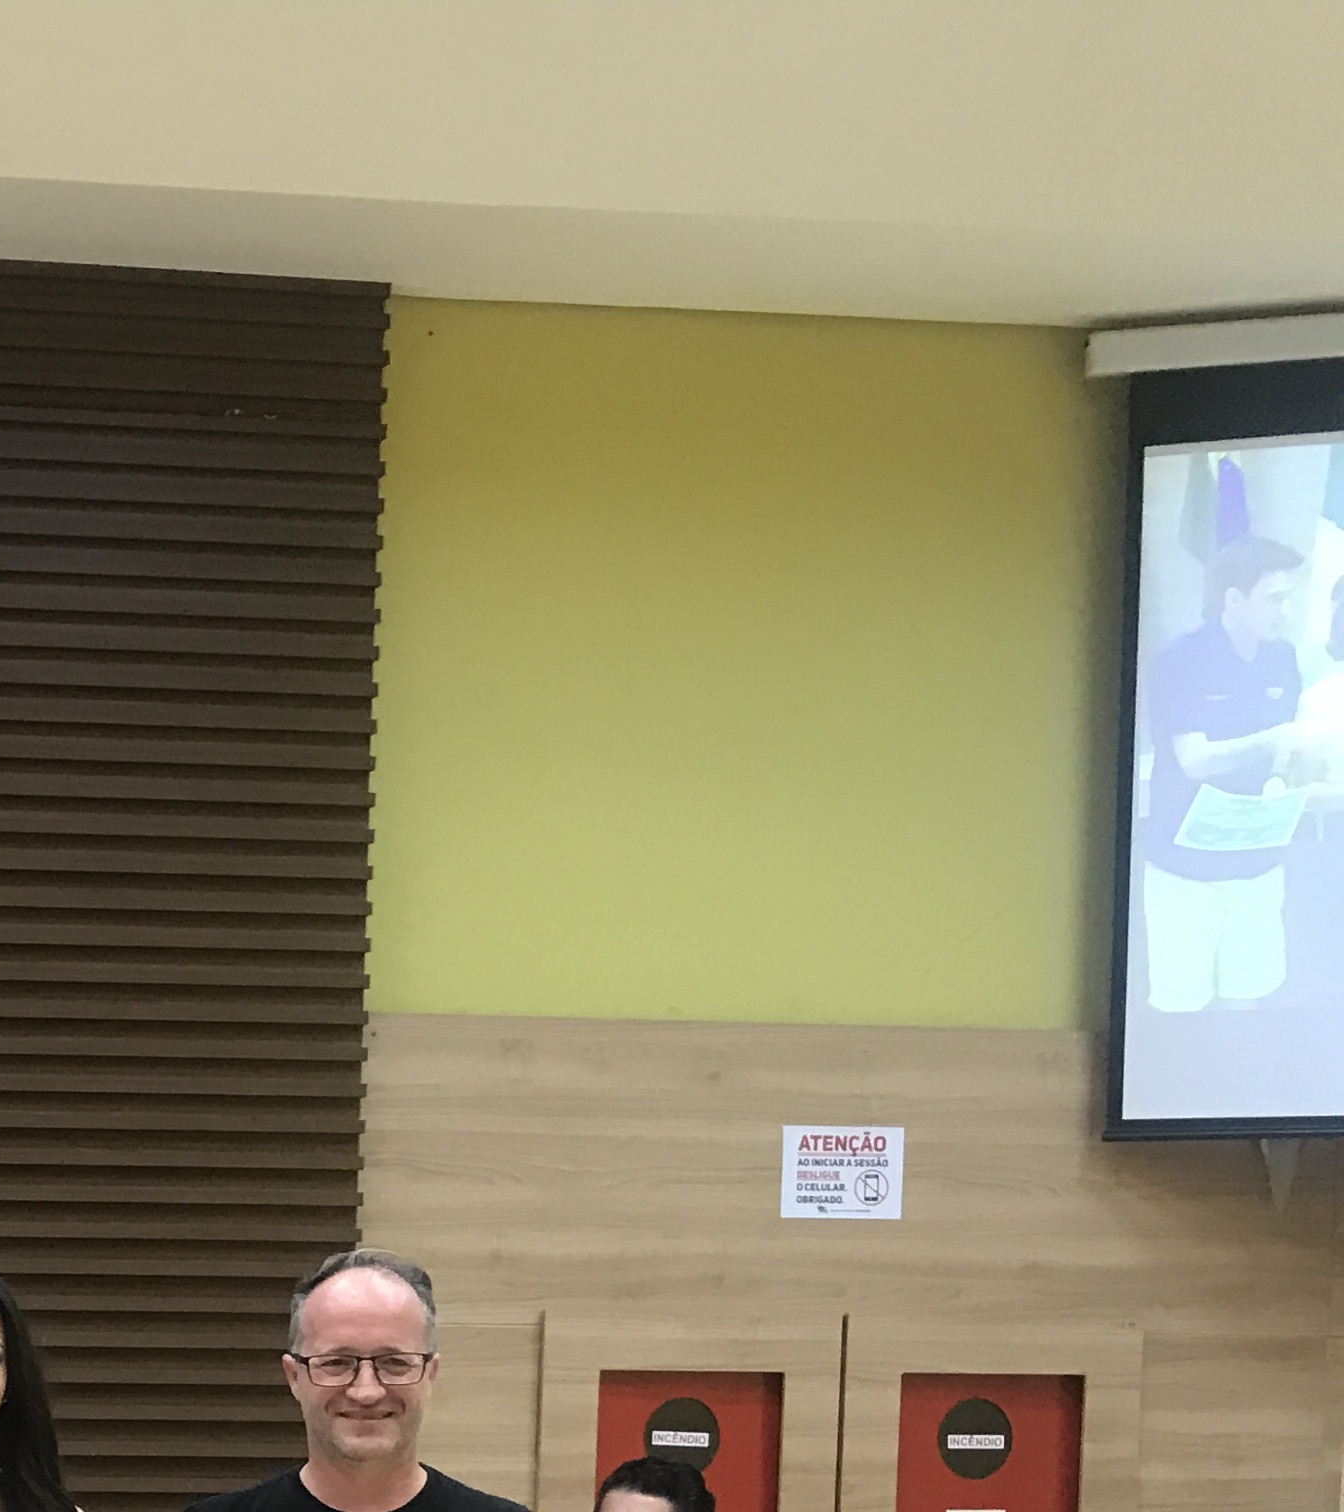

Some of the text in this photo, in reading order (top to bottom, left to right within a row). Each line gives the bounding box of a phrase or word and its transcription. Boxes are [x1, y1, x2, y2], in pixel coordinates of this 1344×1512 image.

[798, 1131, 887, 1157] ATENÇÃO
[797, 1157, 889, 1168] AO INICIAR A SESSÃO
[797, 1170, 840, 1180] DESLIGUE
[796, 1183, 848, 1192] O CELULAR.
[796, 1195, 845, 1204] OBRIGADO.
[653, 1430, 707, 1446] INCÊNDIO
[950, 1434, 1004, 1449] INCÊNDIO
